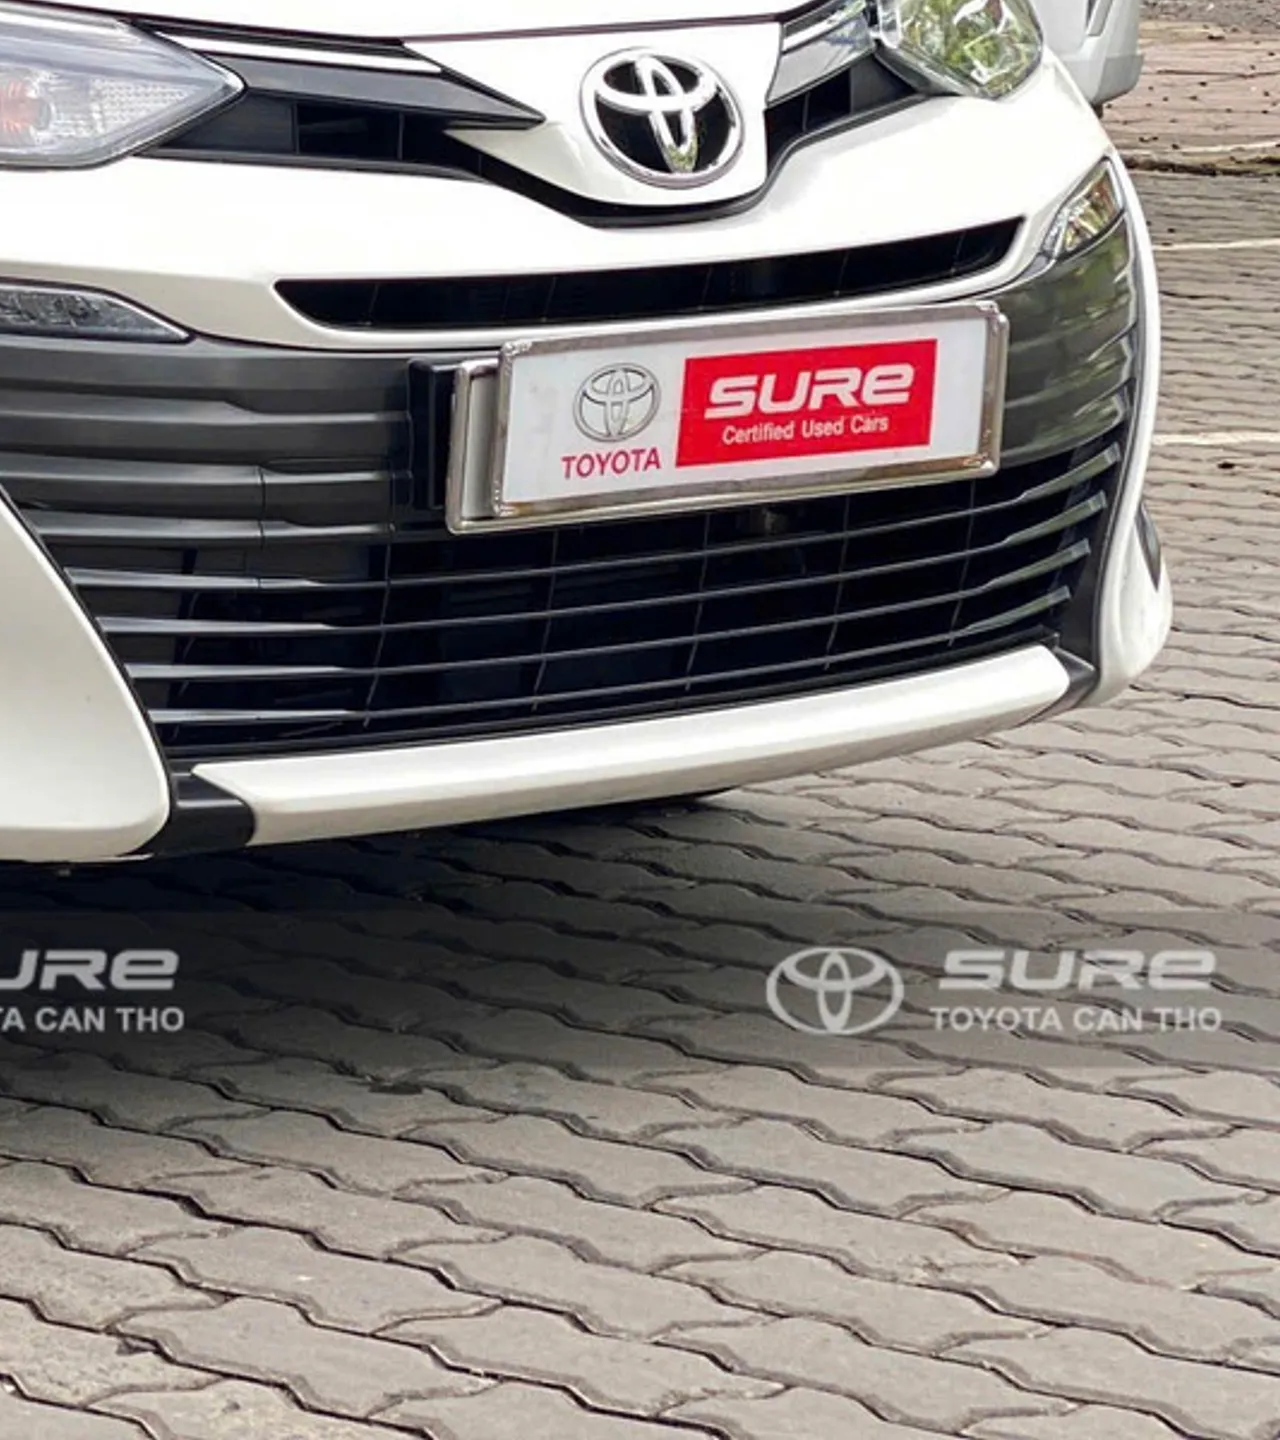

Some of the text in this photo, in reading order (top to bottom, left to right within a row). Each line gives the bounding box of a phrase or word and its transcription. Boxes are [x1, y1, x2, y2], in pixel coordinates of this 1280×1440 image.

[722, 414, 889, 446] Certified Used Cars
[560, 447, 662, 479] TOYOTA
